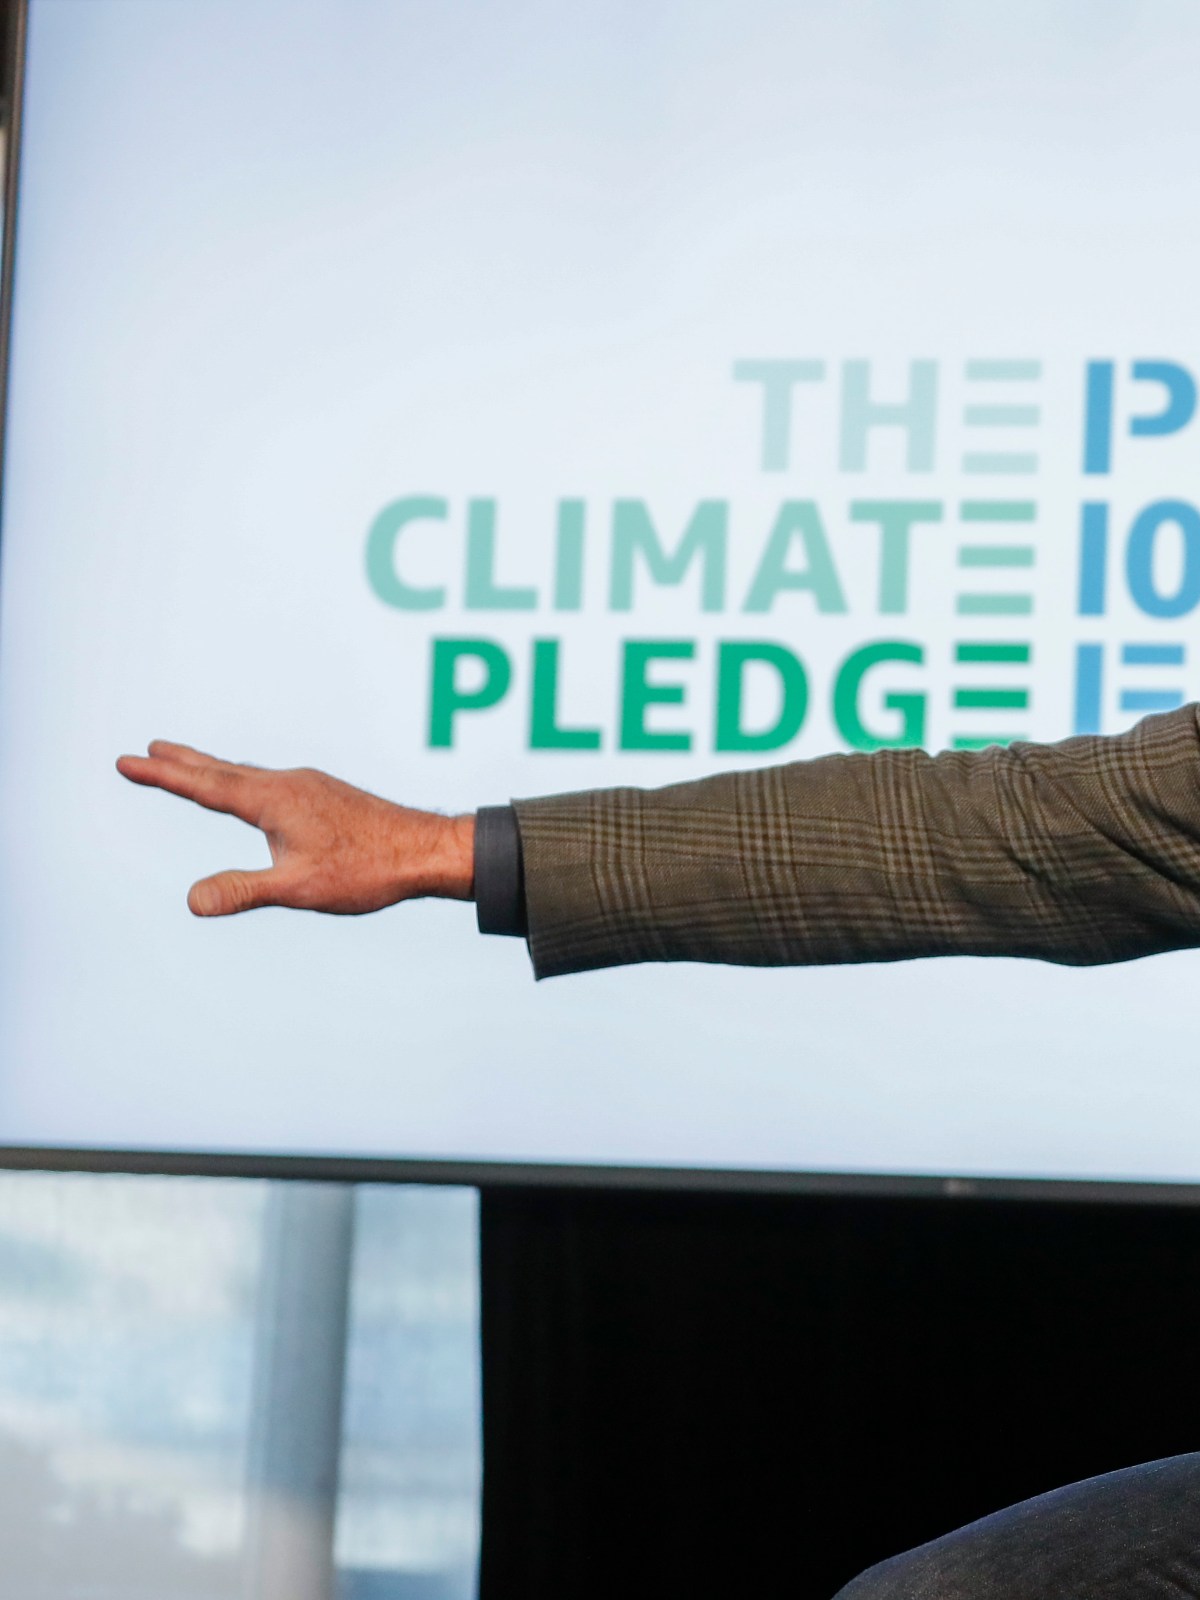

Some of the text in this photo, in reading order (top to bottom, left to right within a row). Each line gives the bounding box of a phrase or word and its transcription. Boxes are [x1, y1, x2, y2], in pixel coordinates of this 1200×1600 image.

[730, 357, 1045, 478] THE
[364, 496, 1037, 616] CLIMATE
[427, 637, 1033, 754] PLEDGE
